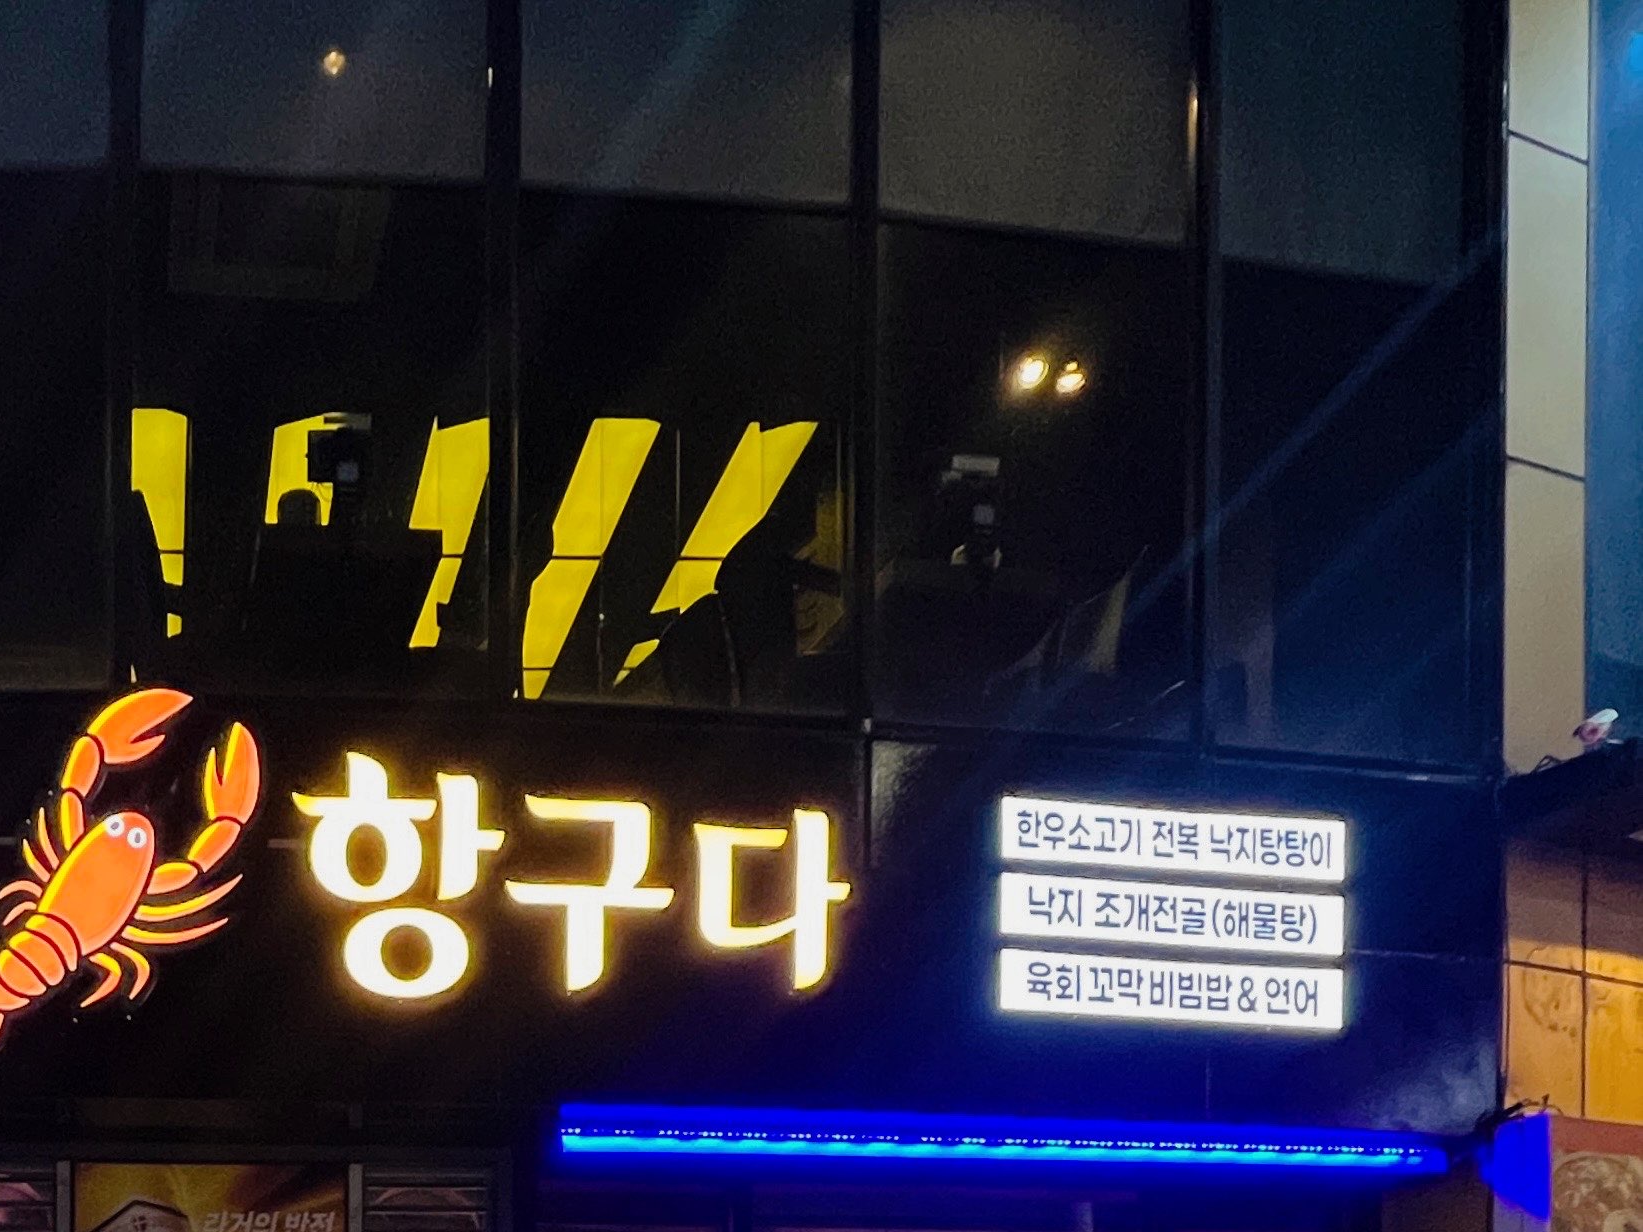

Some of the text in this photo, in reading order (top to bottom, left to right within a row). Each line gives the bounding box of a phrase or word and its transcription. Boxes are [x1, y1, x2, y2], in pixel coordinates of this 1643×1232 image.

[1017, 809, 1332, 869] 한우소고기 전복 낙지탕탕이
[292, 751, 852, 999] 항구다
[1028, 885, 1318, 944] 낙지 조개전골(해물탕)
